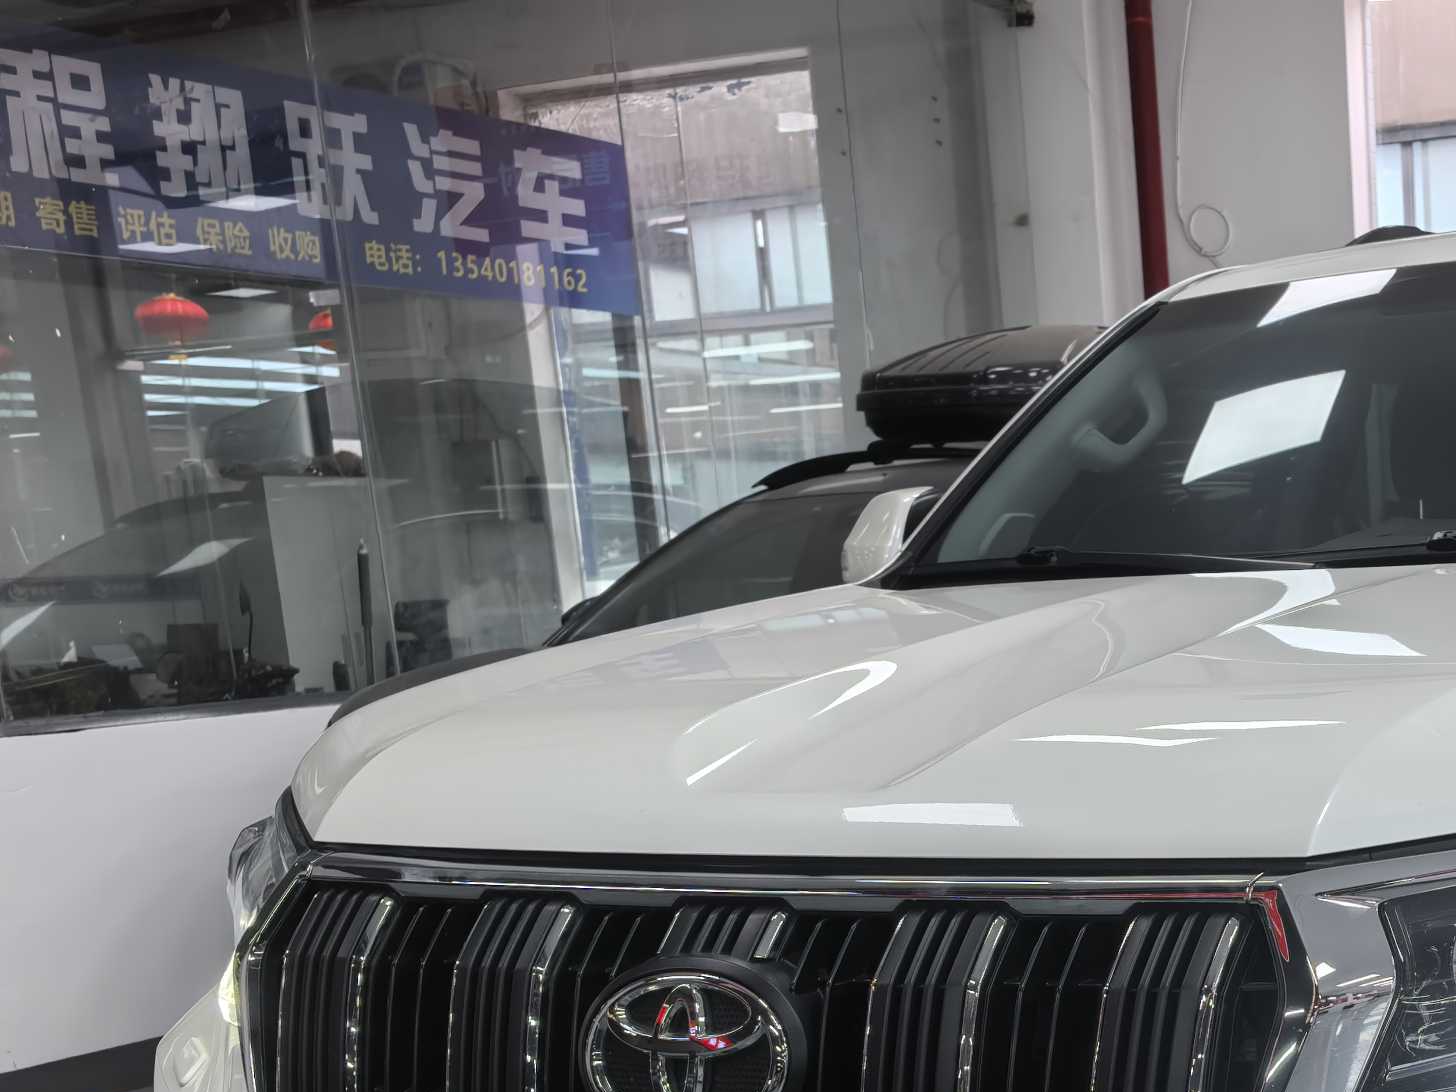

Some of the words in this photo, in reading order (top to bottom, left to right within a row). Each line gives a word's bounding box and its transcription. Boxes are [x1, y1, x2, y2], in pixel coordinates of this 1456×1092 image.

[0, 48, 589, 252] 程翔跃汽车
[34, 197, 98, 238] 寄售
[118, 206, 177, 246] 评估
[197, 216, 252, 255] 保险
[269, 226, 321, 264] 收购
[436, 250, 588, 292] 13540181162
